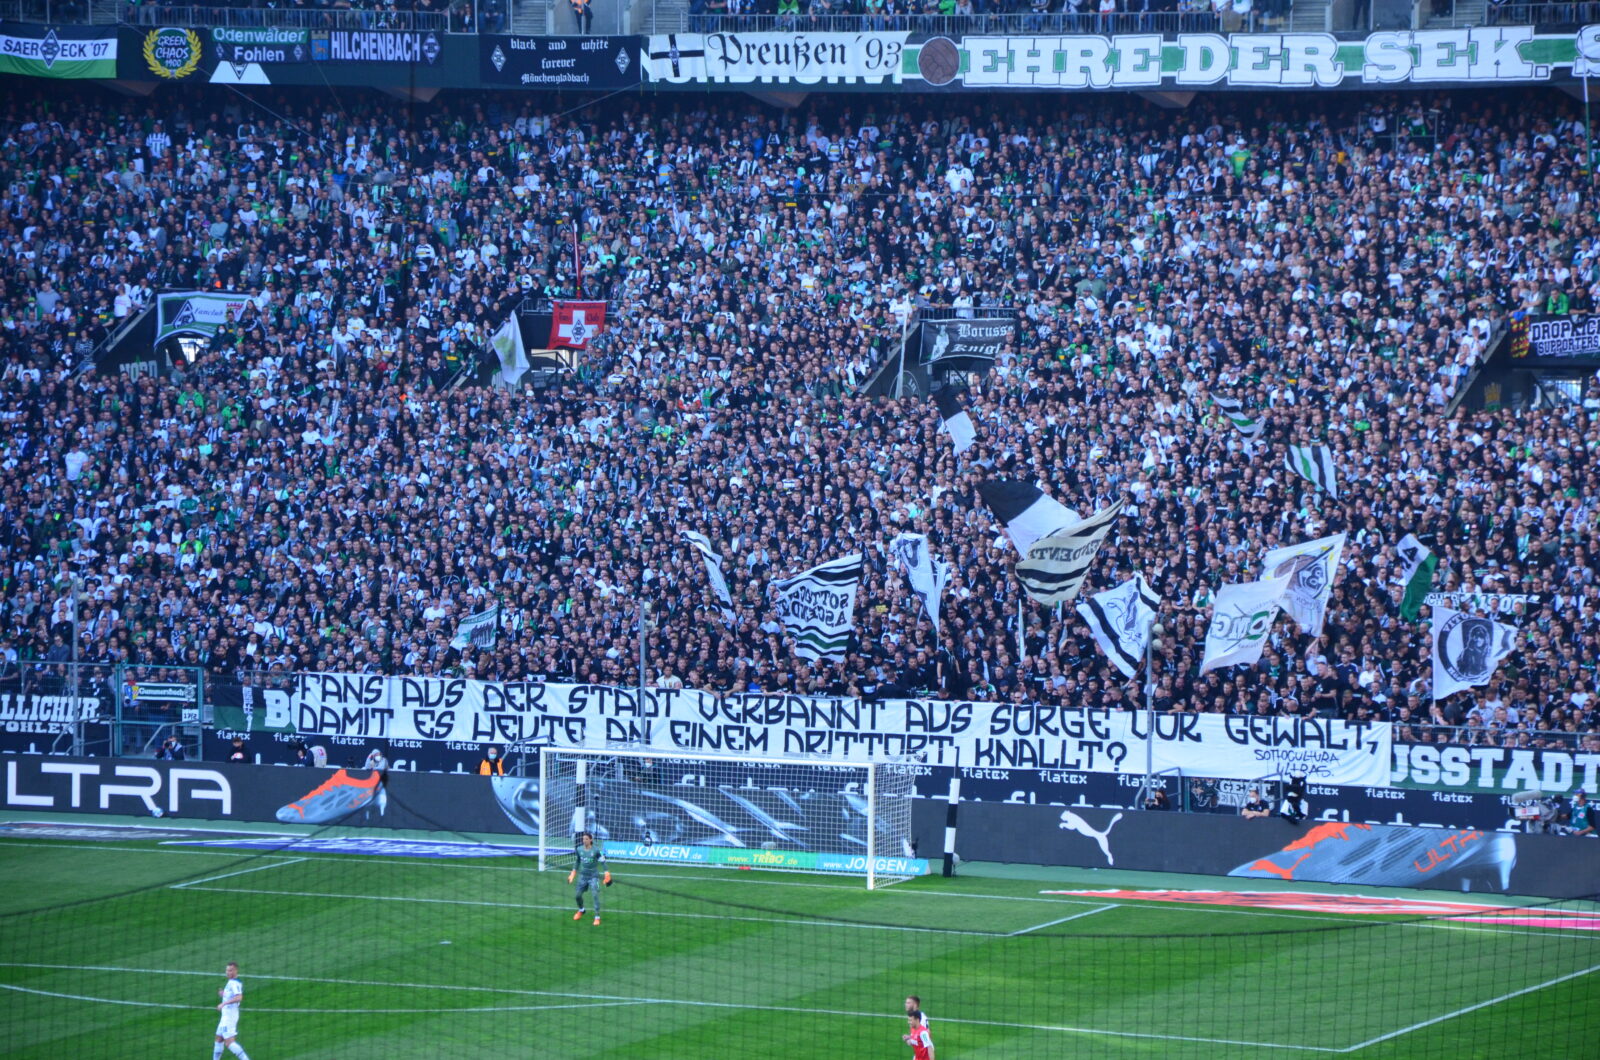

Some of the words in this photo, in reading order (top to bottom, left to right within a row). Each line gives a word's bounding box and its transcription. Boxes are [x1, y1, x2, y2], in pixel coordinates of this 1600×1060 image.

[156, 34, 186, 46] GREEN
[331, 31, 421, 63] HILCHENBACH
[510, 38, 536, 50] black
[548, 39, 566, 50] and
[581, 39, 609, 53] white
[154, 46, 189, 60] CHAOS
[234, 46, 285, 62] Fohlen
[708, 33, 848, 73] Preußen
[962, 34, 1163, 88] EHRE
[1176, 32, 1342, 86] DER
[1363, 26, 1552, 84] SEK.
[164, 58, 182, 69] 1900
[1537, 335, 1599, 355] SUPPORTERS
[300, 673, 384, 705] FANS
[402, 677, 466, 708] AUS
[483, 684, 548, 713] DER
[568, 686, 680, 718] STADT
[698, 692, 886, 731] VERBANNT
[906, 700, 973, 733] AUS
[990, 704, 1110, 740] SORGE
[1131, 709, 1202, 743] VOR
[299, 702, 394, 736] DAMIT
[413, 709, 455, 740] ES
[471, 712, 586, 744] HEUTE
[670, 720, 768, 752] EINEM
[974, 737, 1128, 772] KNALLT?
[331, 735, 365, 746] flatex
[388, 738, 422, 749] flatex
[446, 740, 480, 751] flatex
[962, 767, 1009, 780] flatex
[1039, 770, 1087, 784] flatex
[7, 761, 232, 815] LTRA
[1365, 788, 1405, 800] flatex
[1432, 791, 1473, 803] flatex
[629, 845, 691, 859] JONGEN
[845, 857, 907, 872] JOGEN
